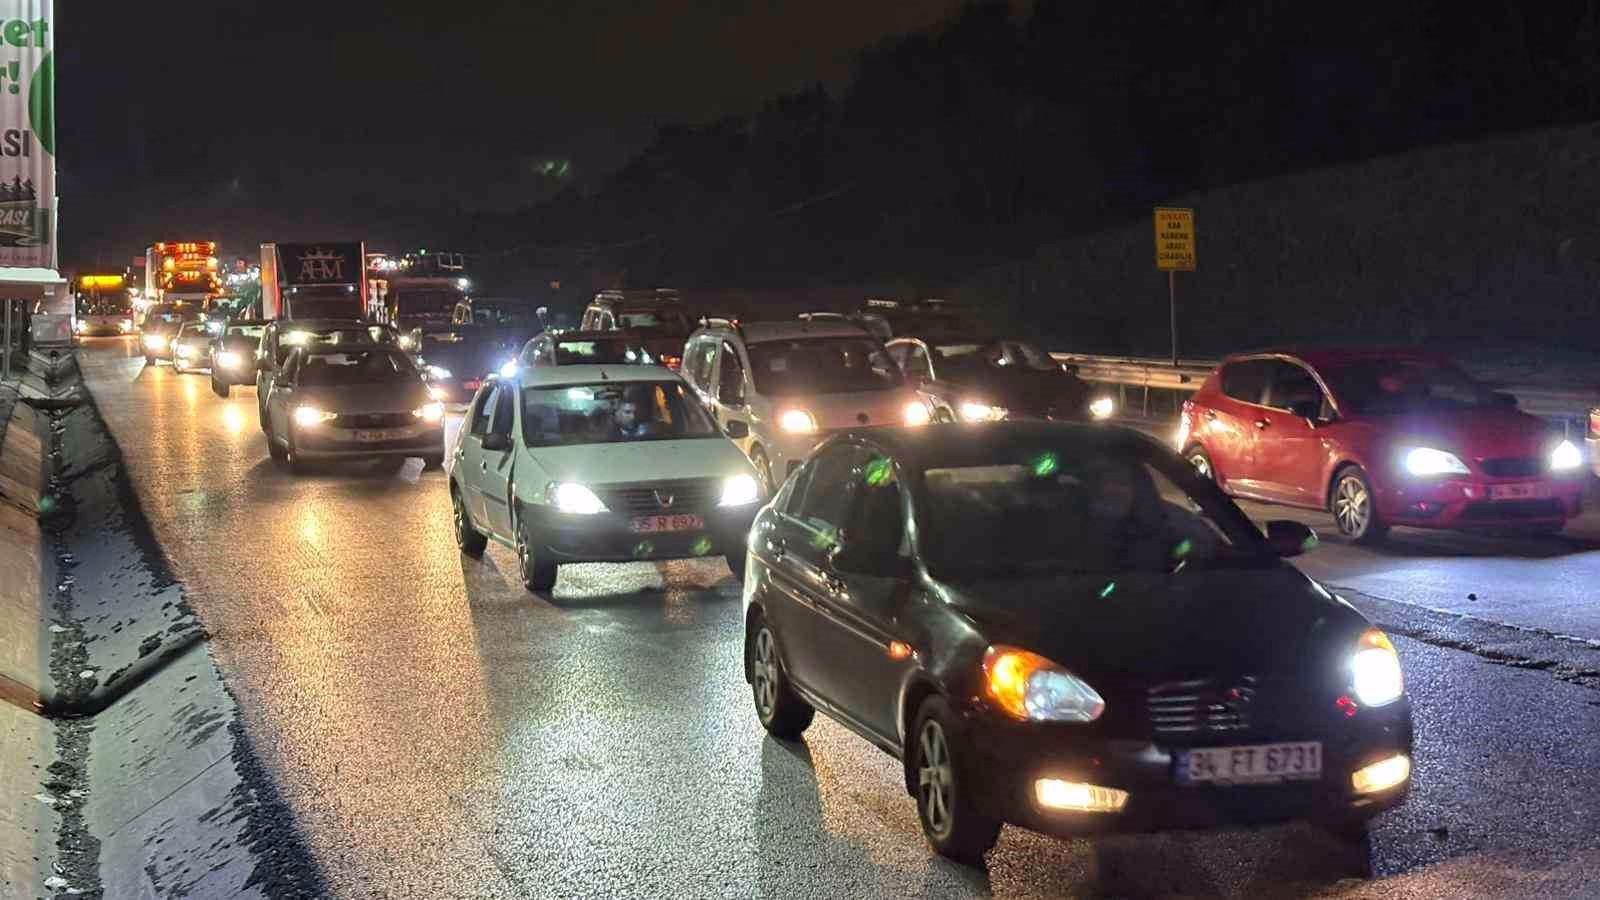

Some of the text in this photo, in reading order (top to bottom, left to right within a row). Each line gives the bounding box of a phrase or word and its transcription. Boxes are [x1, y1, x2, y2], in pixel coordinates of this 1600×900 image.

[0, 17, 48, 48] et
[0, 129, 31, 157] SI
[1191, 746, 1317, 776] 34 FT 6731
